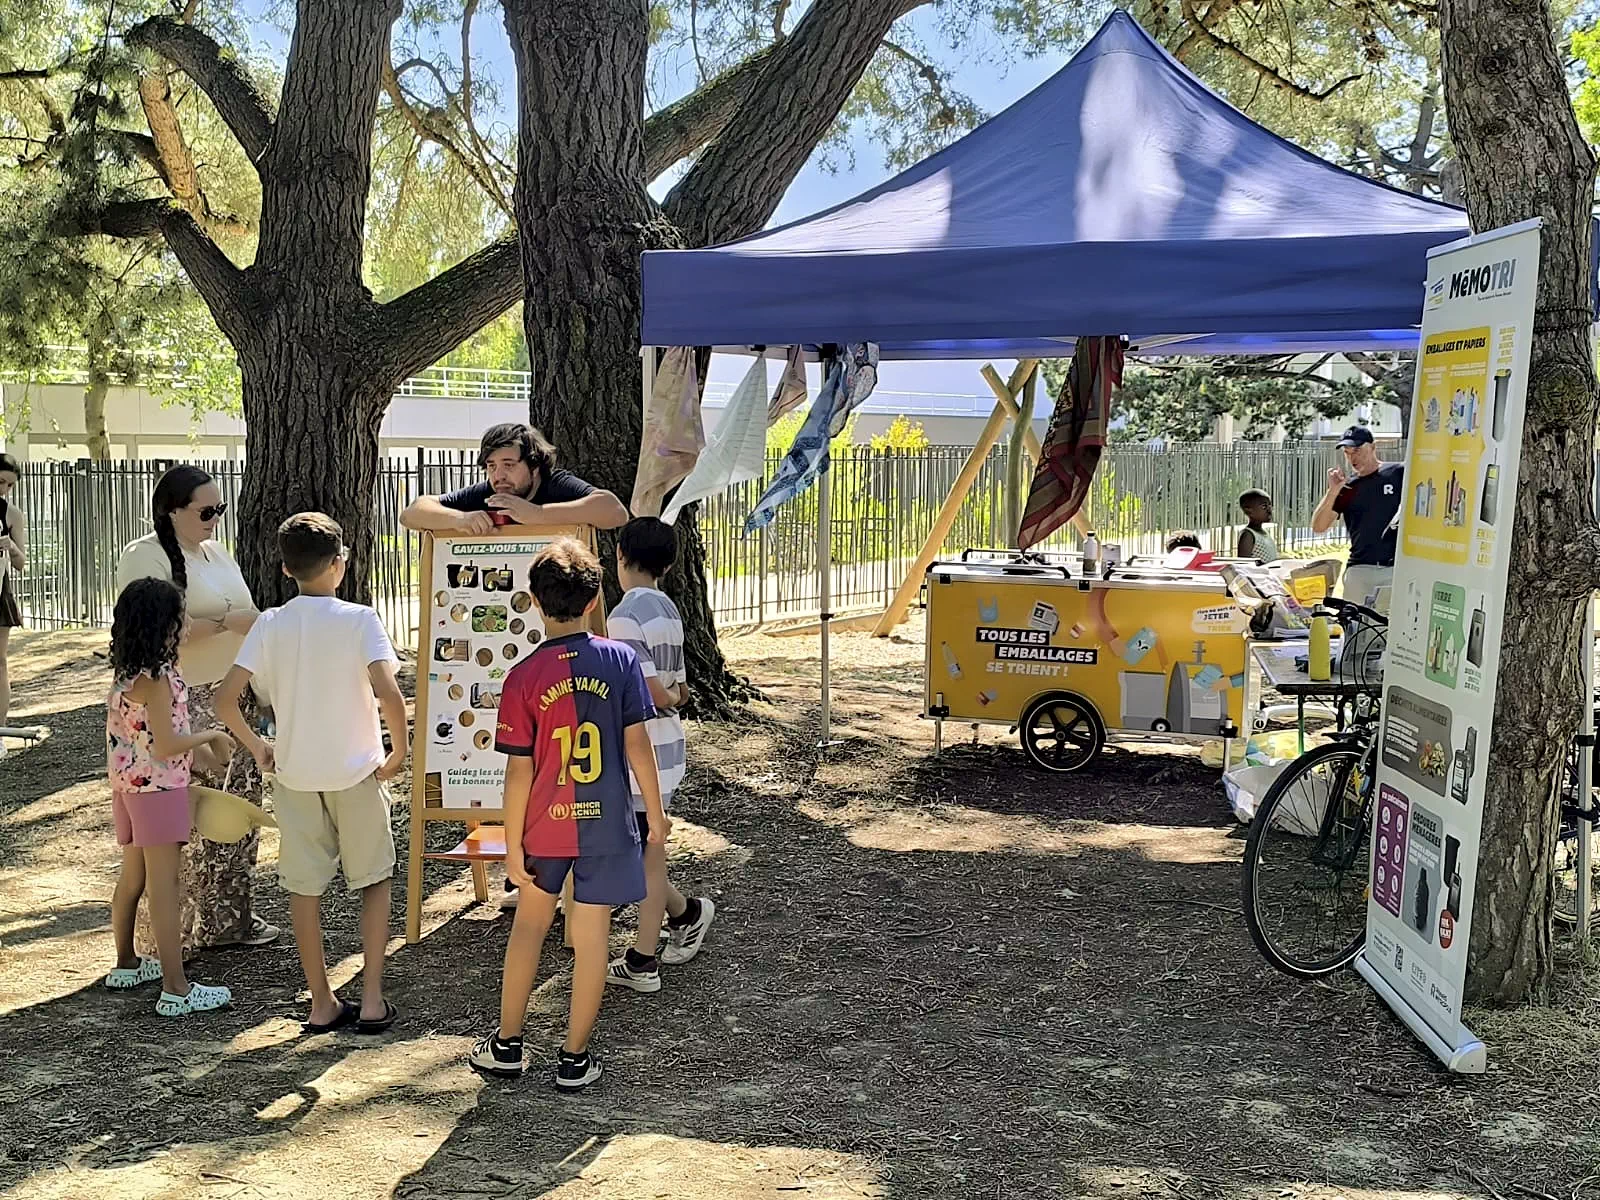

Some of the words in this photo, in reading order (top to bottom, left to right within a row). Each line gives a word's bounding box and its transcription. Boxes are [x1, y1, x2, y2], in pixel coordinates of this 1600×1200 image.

[1383, 484, 1394, 495] R
[453, 543, 518, 554] SAVEZ-VOUS
[1203, 612, 1230, 620] JETER
[979, 629, 1018, 642] TOUS
[1020, 631, 1047, 644] LES
[998, 646, 1094, 663] EMBALLAGES
[986, 662, 1004, 673] SE
[1008, 663, 1060, 677] TRIENT
[538, 677, 574, 712] LAMINE
[574, 676, 610, 700] YAMAL
[551, 720, 602, 786] 19
[447, 768, 480, 778] Guidez
[480, 768, 492, 776] les
[448, 777, 461, 785] les
[462, 777, 495, 785] bonnes
[569, 800, 601, 810] UNHCR
[570, 808, 602, 817] ACNUR
